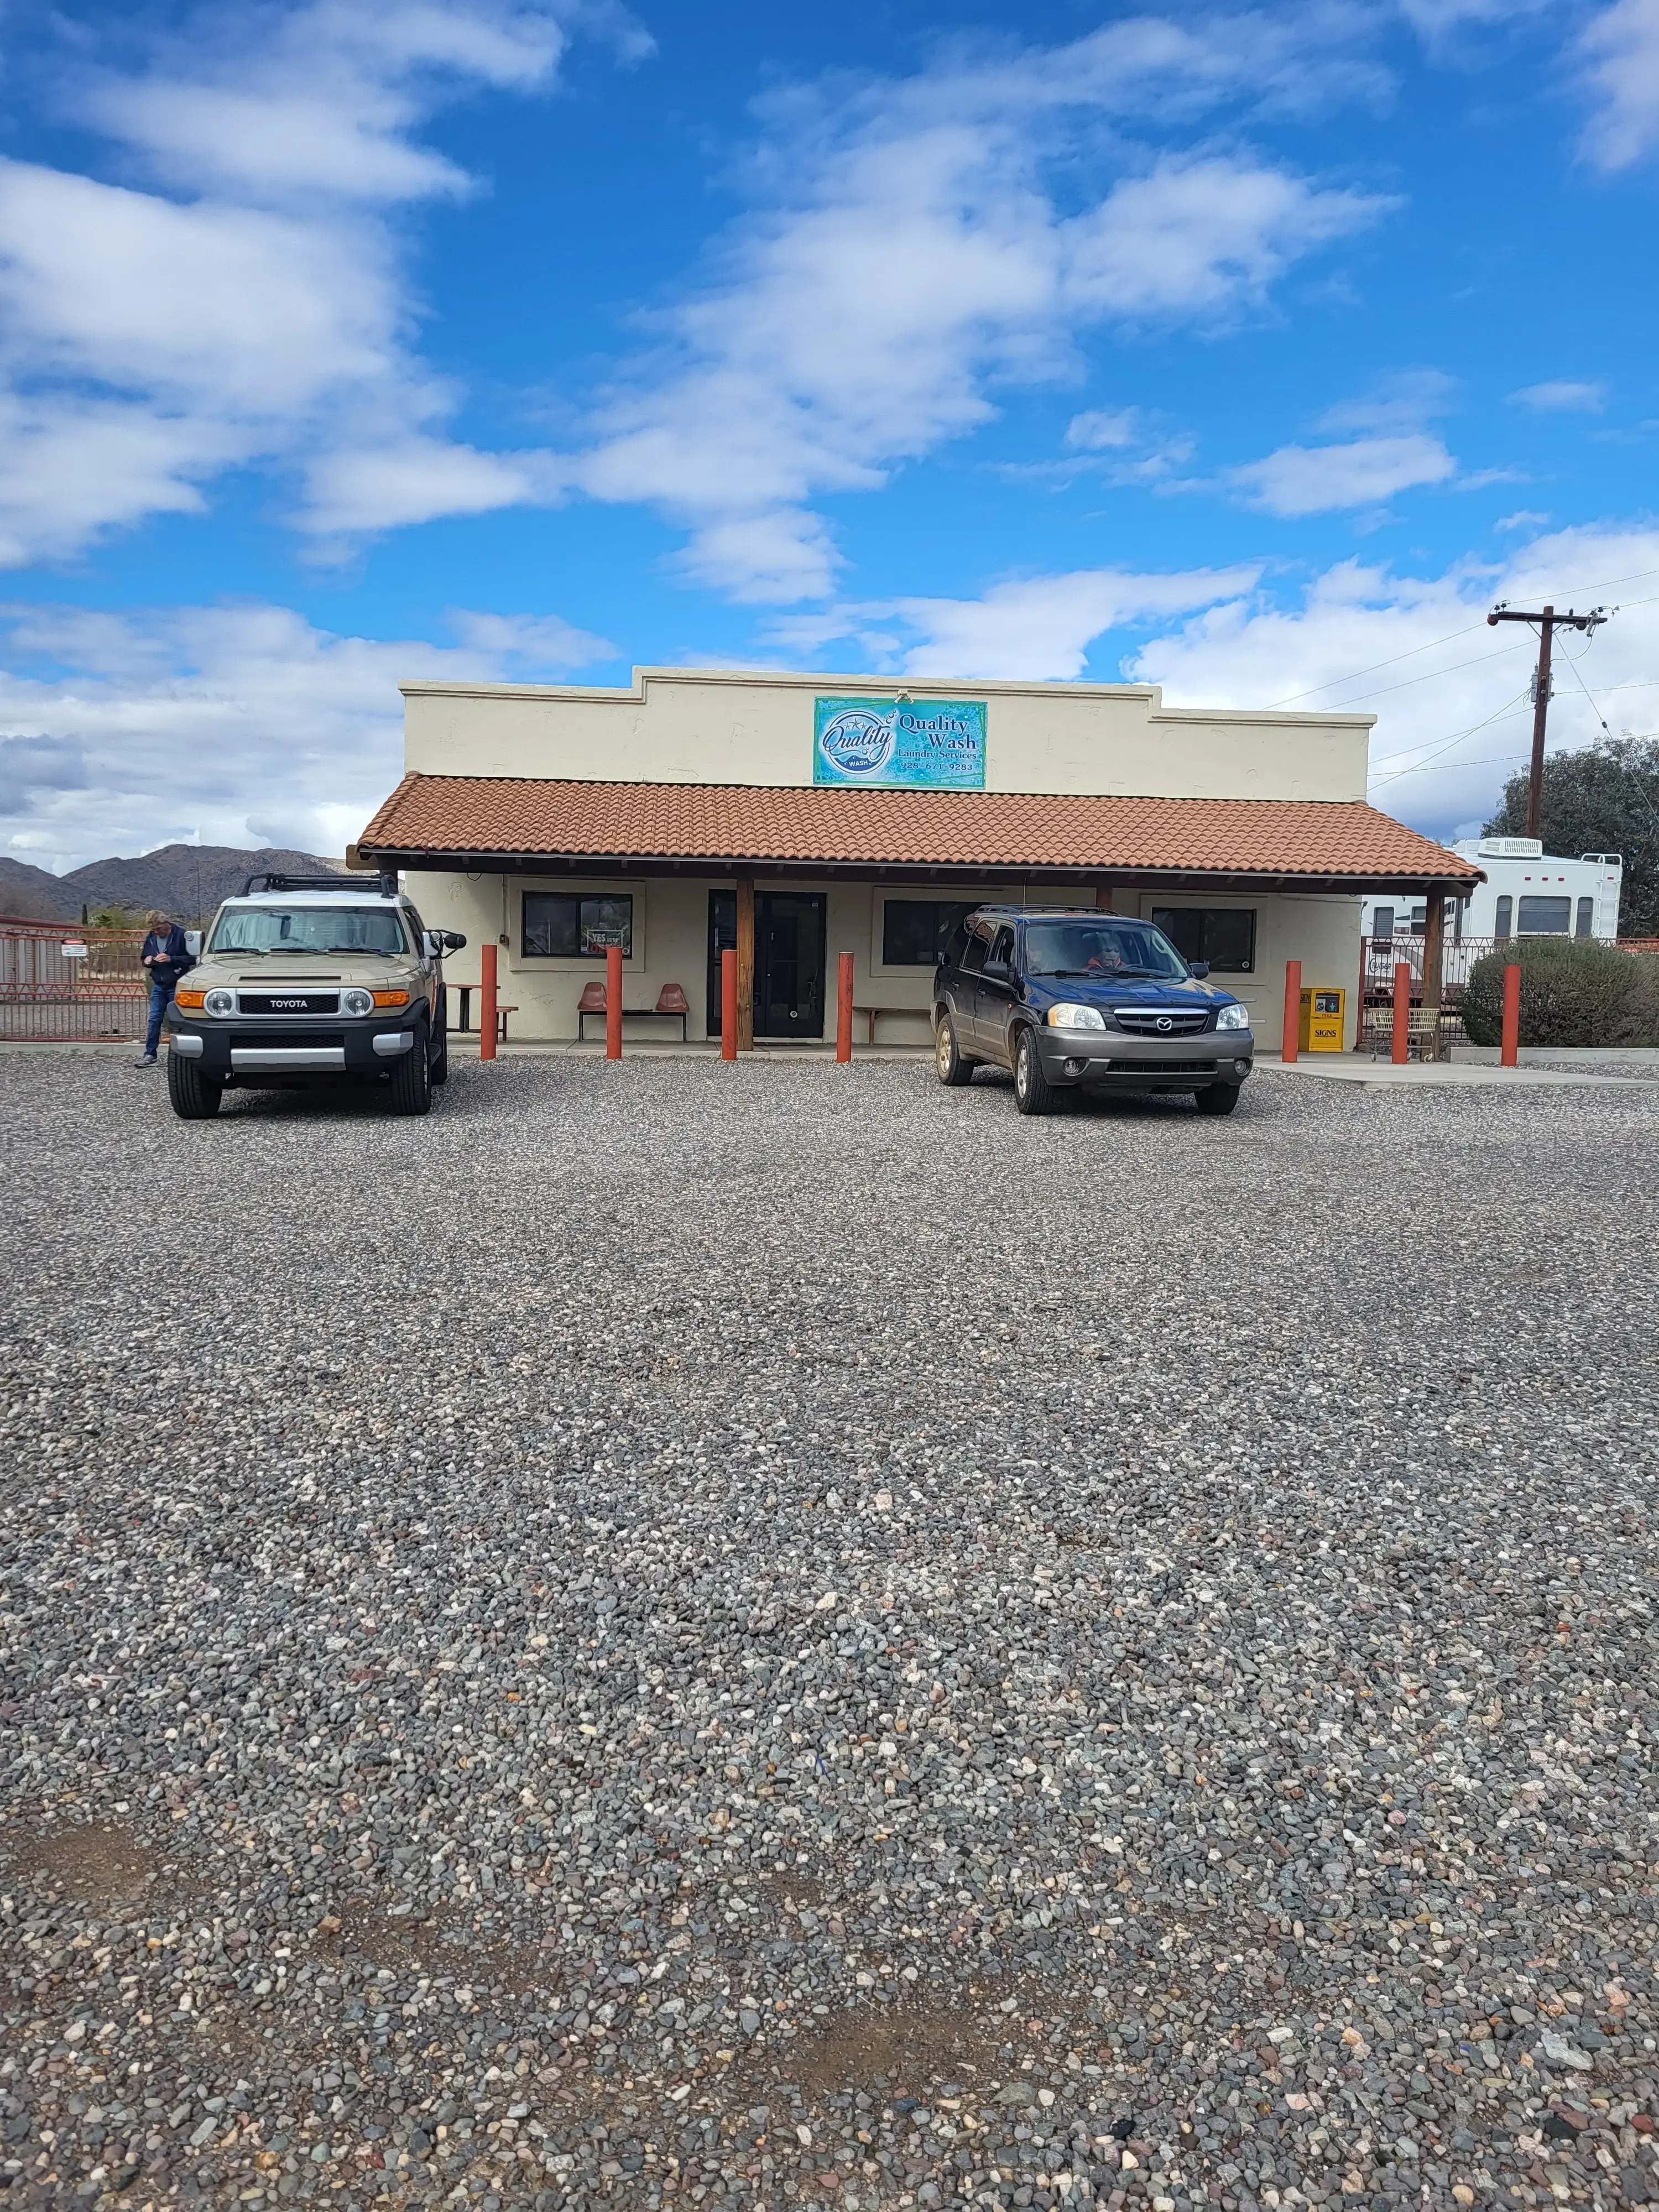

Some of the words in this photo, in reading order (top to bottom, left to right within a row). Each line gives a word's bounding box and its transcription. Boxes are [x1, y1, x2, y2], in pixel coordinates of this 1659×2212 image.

[899, 714, 968, 736] Quality
[822, 725, 893, 760] Quality
[927, 733, 977, 749] Wash
[898, 749, 935, 759] Laundry
[939, 750, 977, 759] Services
[901, 763, 973, 771] 928-671-9283
[592, 933, 606, 942] YES
[1369, 958, 1392, 973] CRUISER
